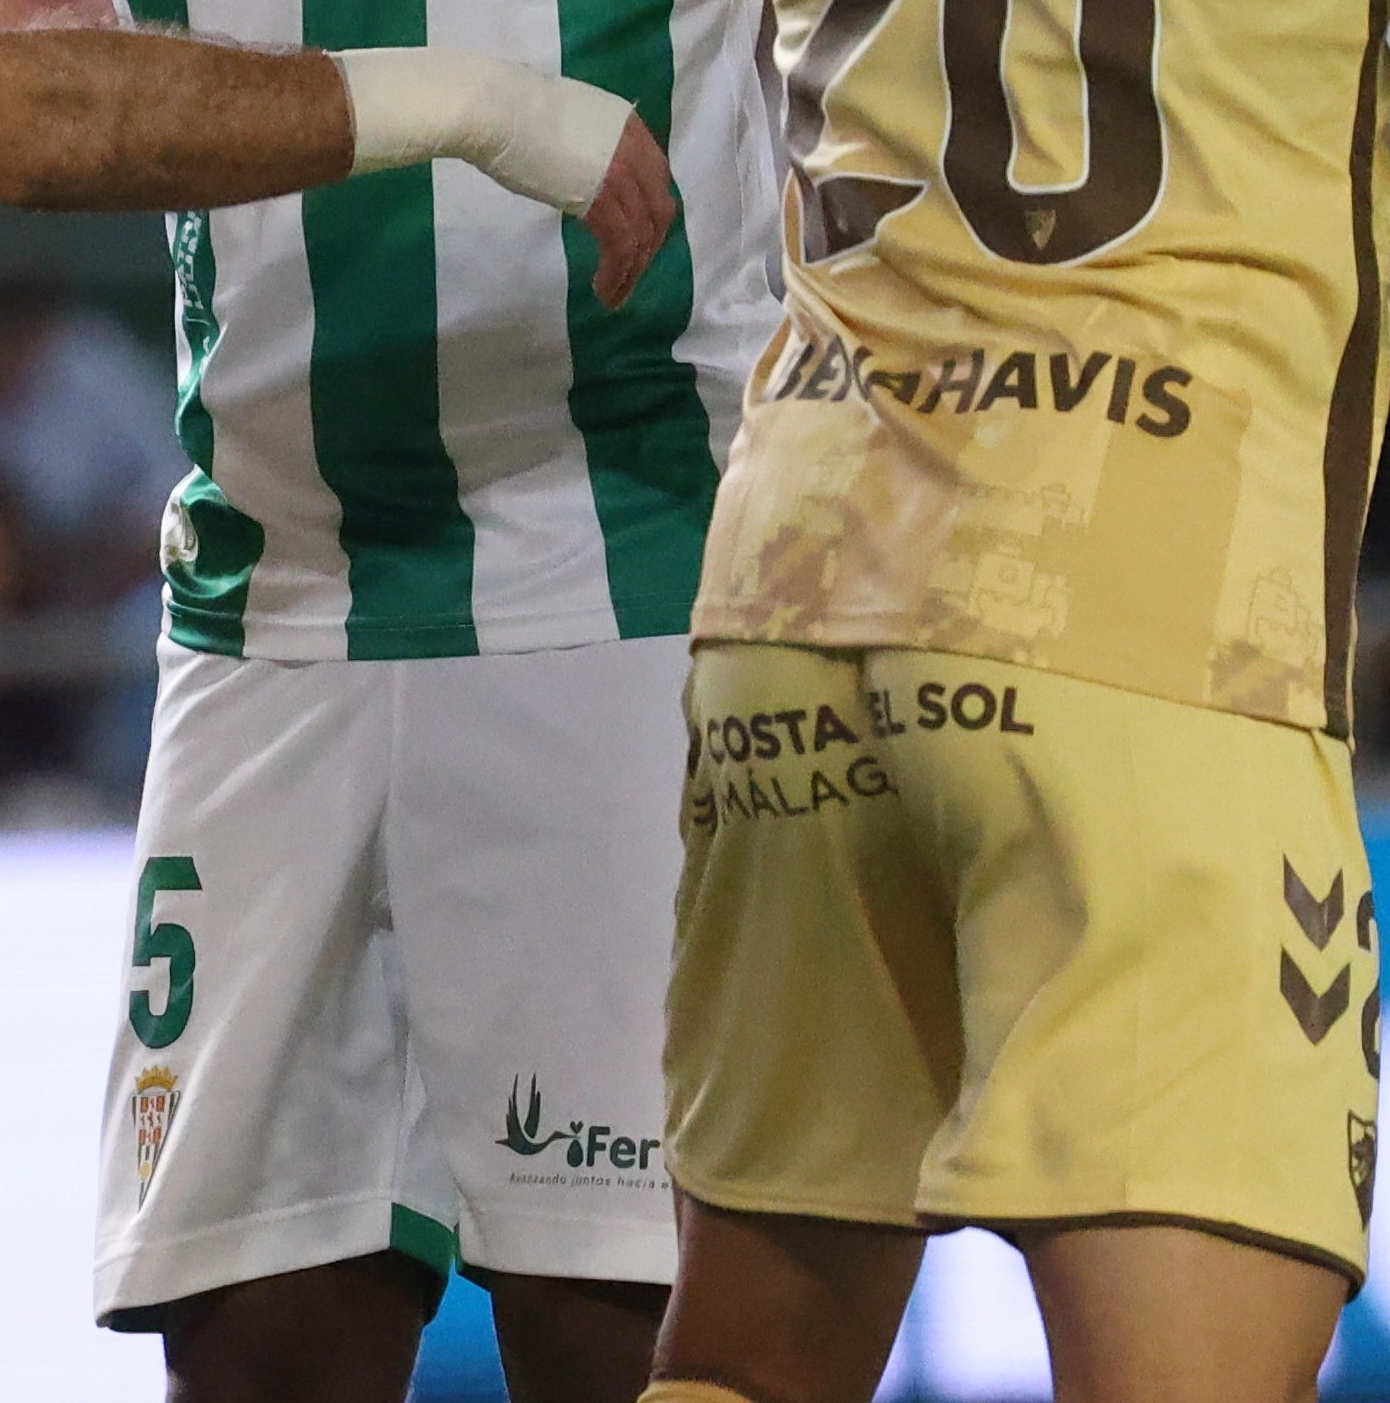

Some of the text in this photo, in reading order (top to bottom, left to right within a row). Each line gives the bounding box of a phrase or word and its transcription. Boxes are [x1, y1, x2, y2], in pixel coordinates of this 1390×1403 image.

[707, 704, 860, 765] COSTA
[917, 682, 1035, 737] SOL
[722, 756, 899, 825] MÁLAG
[128, 856, 203, 1049] 5
